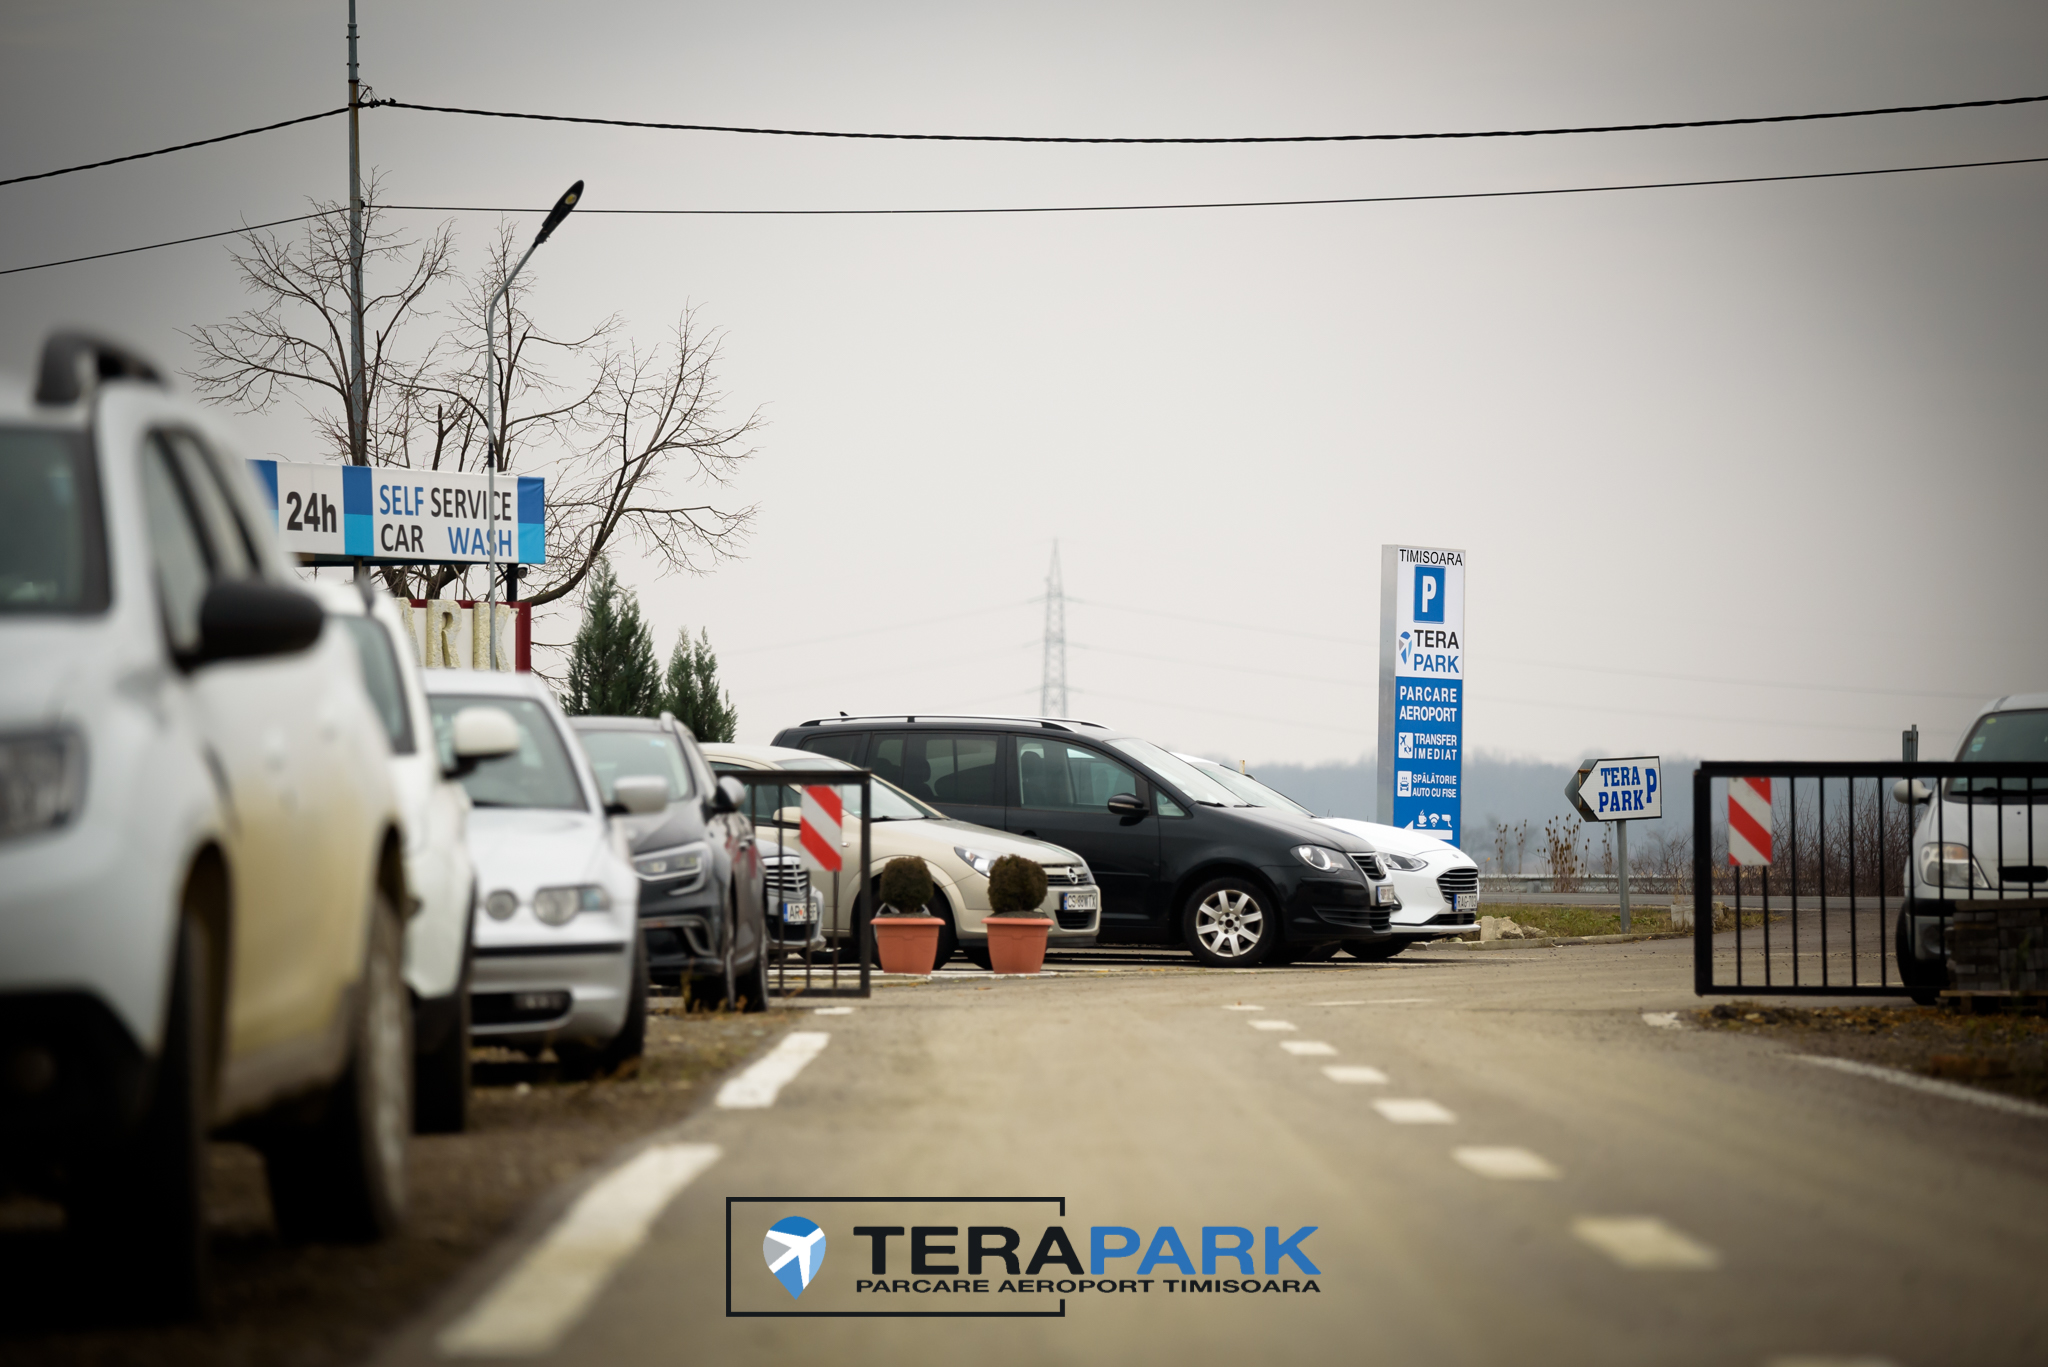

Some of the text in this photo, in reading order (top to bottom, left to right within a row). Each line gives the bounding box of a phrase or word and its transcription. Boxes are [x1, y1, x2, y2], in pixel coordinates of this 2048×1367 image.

[286, 491, 337, 533] 24h
[379, 484, 512, 521] SELF SERVICE
[380, 523, 512, 557] CAR WASH
[1399, 549, 1463, 566] TIMISOARA
[1421, 575, 1437, 613] P
[1414, 629, 1460, 649] TERA
[1413, 653, 1460, 673] PARK
[1399, 686, 1457, 703] PARCARE
[1399, 705, 1457, 722] AEROPORT
[1414, 733, 1457, 747] TRANSFER
[1414, 748, 1457, 761] IMEDIAT
[1600, 766, 1641, 787] TERA
[1645, 768, 1657, 803] P
[1412, 787, 1457, 799] AUTO CU FISE
[1598, 789, 1644, 813] PARK
